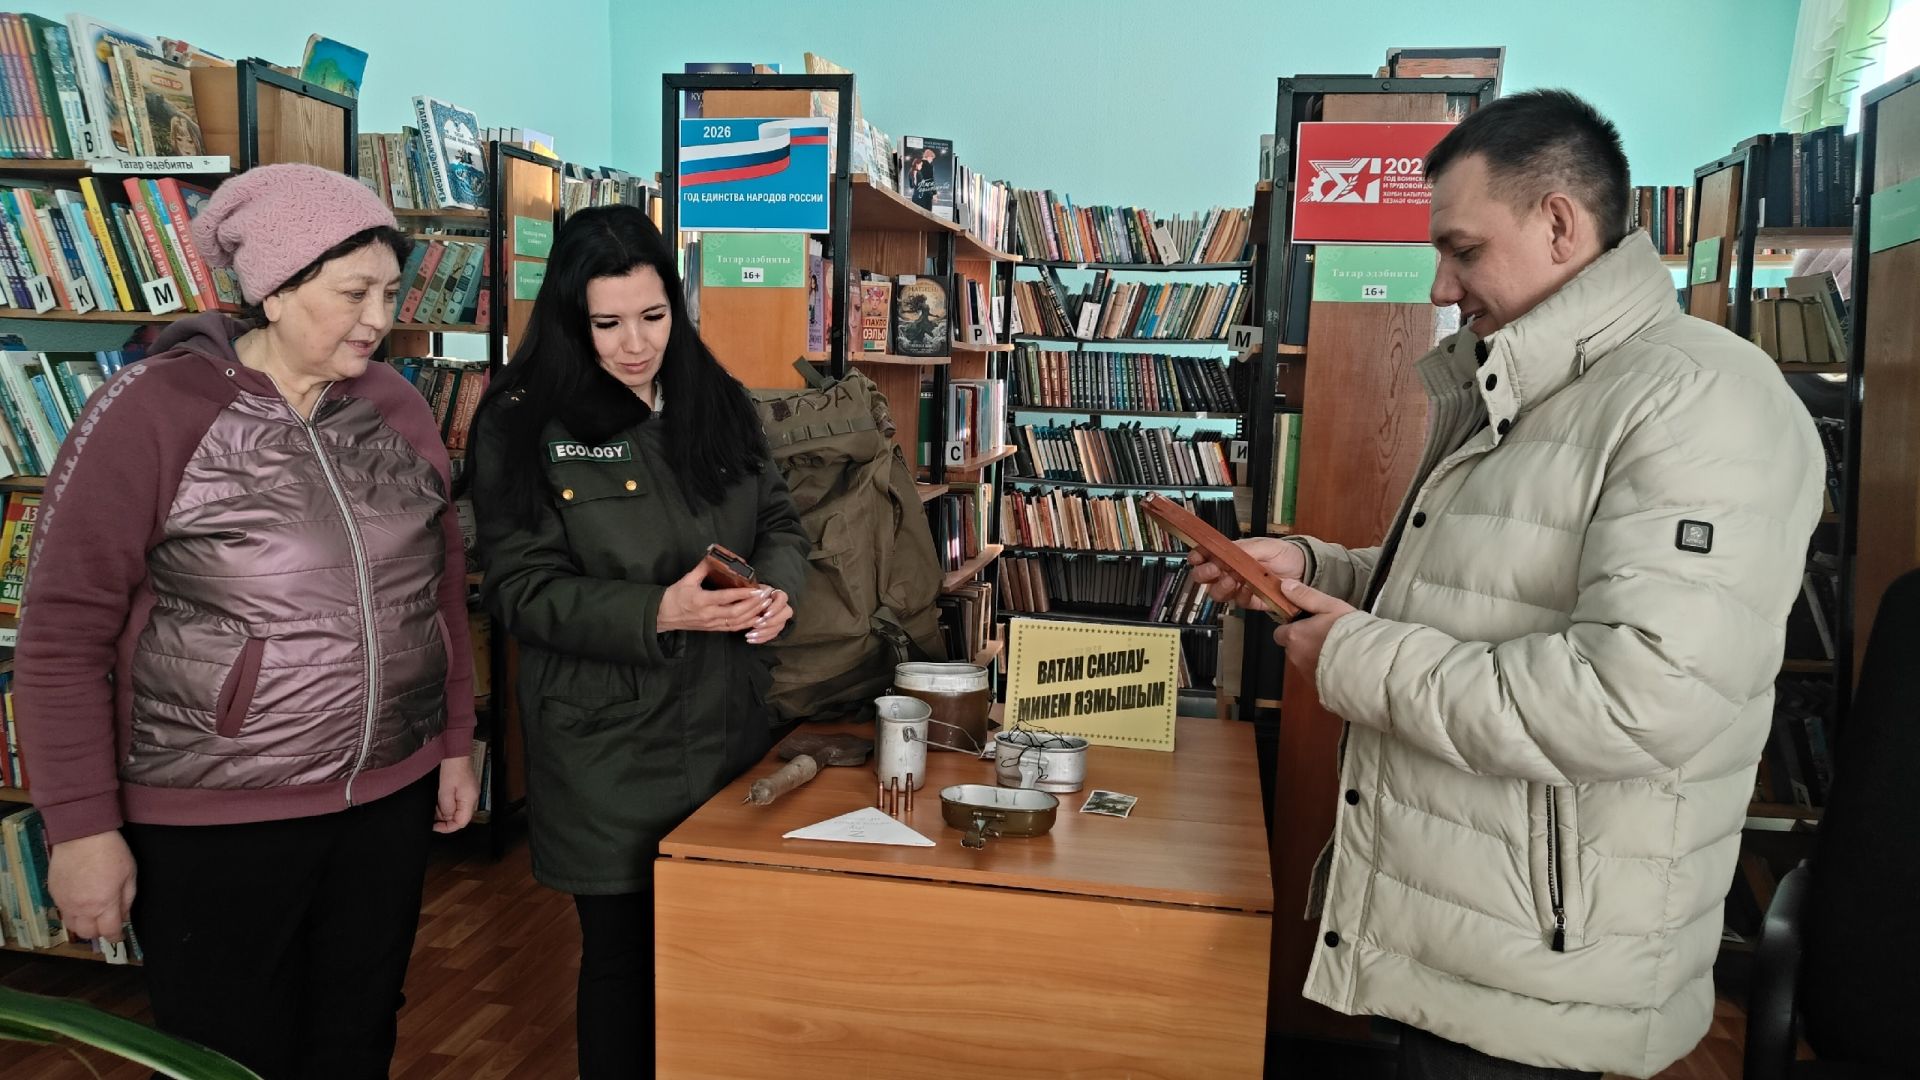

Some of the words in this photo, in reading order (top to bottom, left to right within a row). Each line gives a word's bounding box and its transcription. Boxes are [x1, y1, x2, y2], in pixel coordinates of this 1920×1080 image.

[703, 126, 732, 138] 2026
[84, 132, 93, 152] В
[118, 160, 144, 171] Татар
[1385, 158, 1422, 174] 202
[683, 193, 700, 202] ГОД
[701, 192, 744, 202] ЕДИНСТВА
[747, 193, 786, 203] НАРОДОВ
[789, 193, 823, 202] РОССИИ
[716, 256, 744, 264] Татар
[1332, 268, 1363, 278] Татар
[35, 281, 47, 303] И
[76, 287, 89, 307] К
[153, 283, 173, 306] М
[1364, 288, 1385, 296] 16+
[974, 328, 983, 341] Р
[1235, 331, 1251, 348] М
[54, 455, 78, 502] ALL
[74, 364, 148, 454] ASPECTS
[556, 445, 623, 458] ECOLOGY
[950, 446, 961, 461] С
[22, 506, 38, 521] АЗ
[1038, 656, 1084, 684] ВАТАН
[1087, 648, 1149, 678] САКЛАУ-
[1018, 693, 1071, 720] МИНЕМ
[1074, 682, 1165, 715] ЯЗМЫШЫМ
